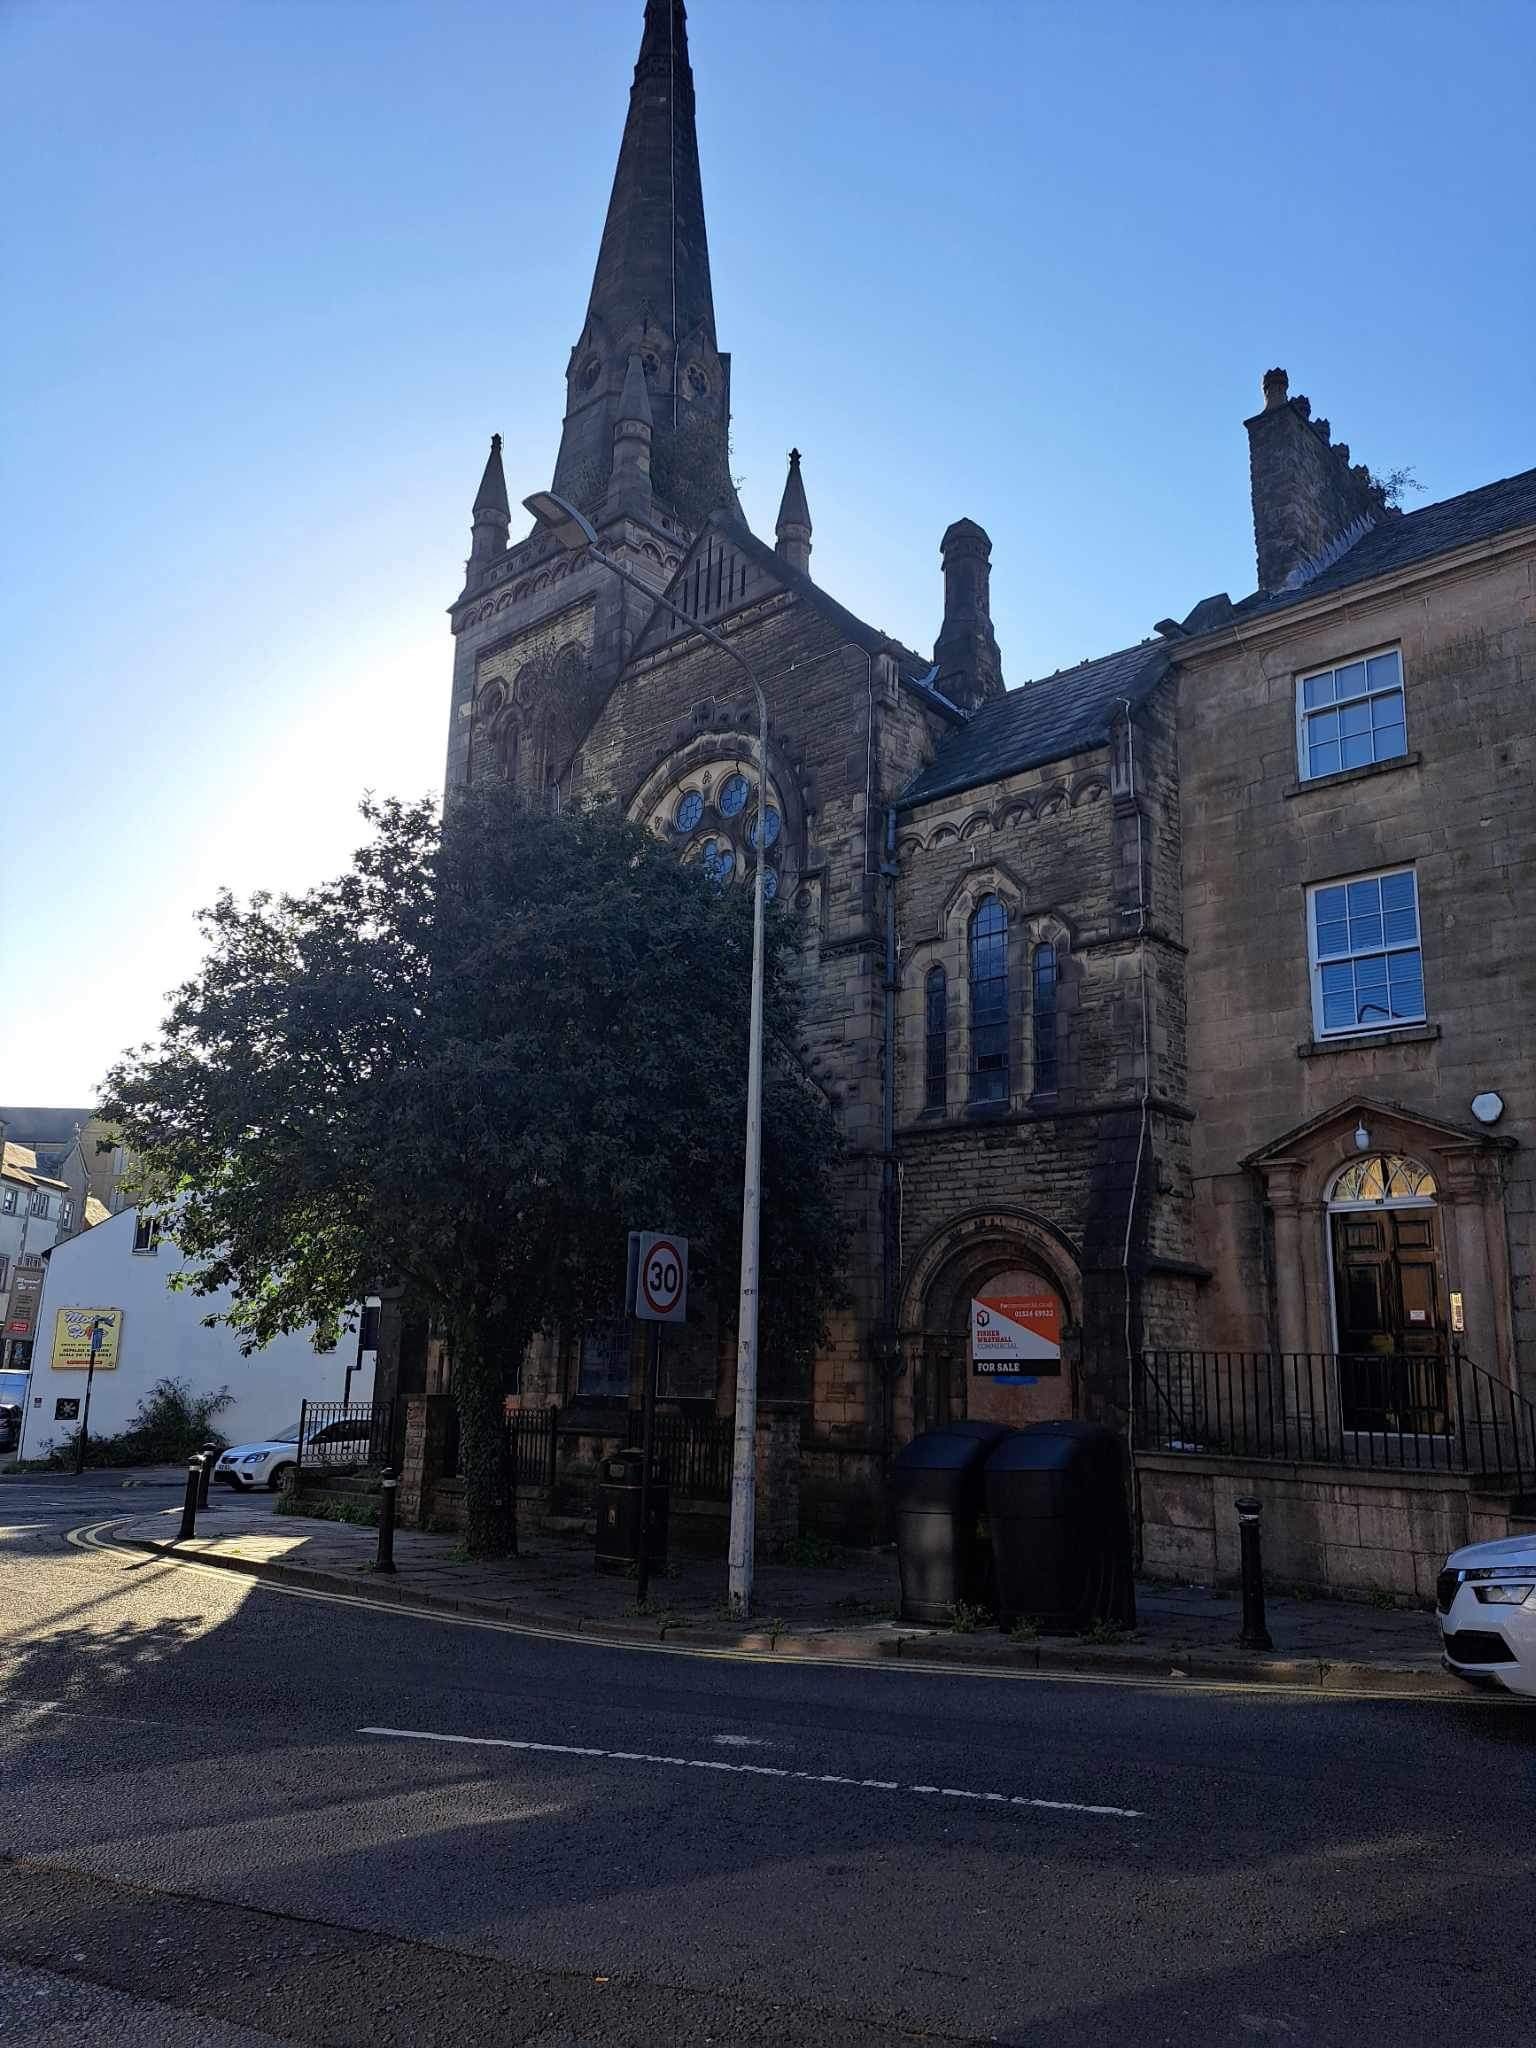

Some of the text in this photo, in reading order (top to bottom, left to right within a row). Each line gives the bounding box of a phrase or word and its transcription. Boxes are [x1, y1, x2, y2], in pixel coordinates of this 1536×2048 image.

[649, 1262, 677, 1293] 30
[977, 1362, 1020, 1372] FOR SALE
